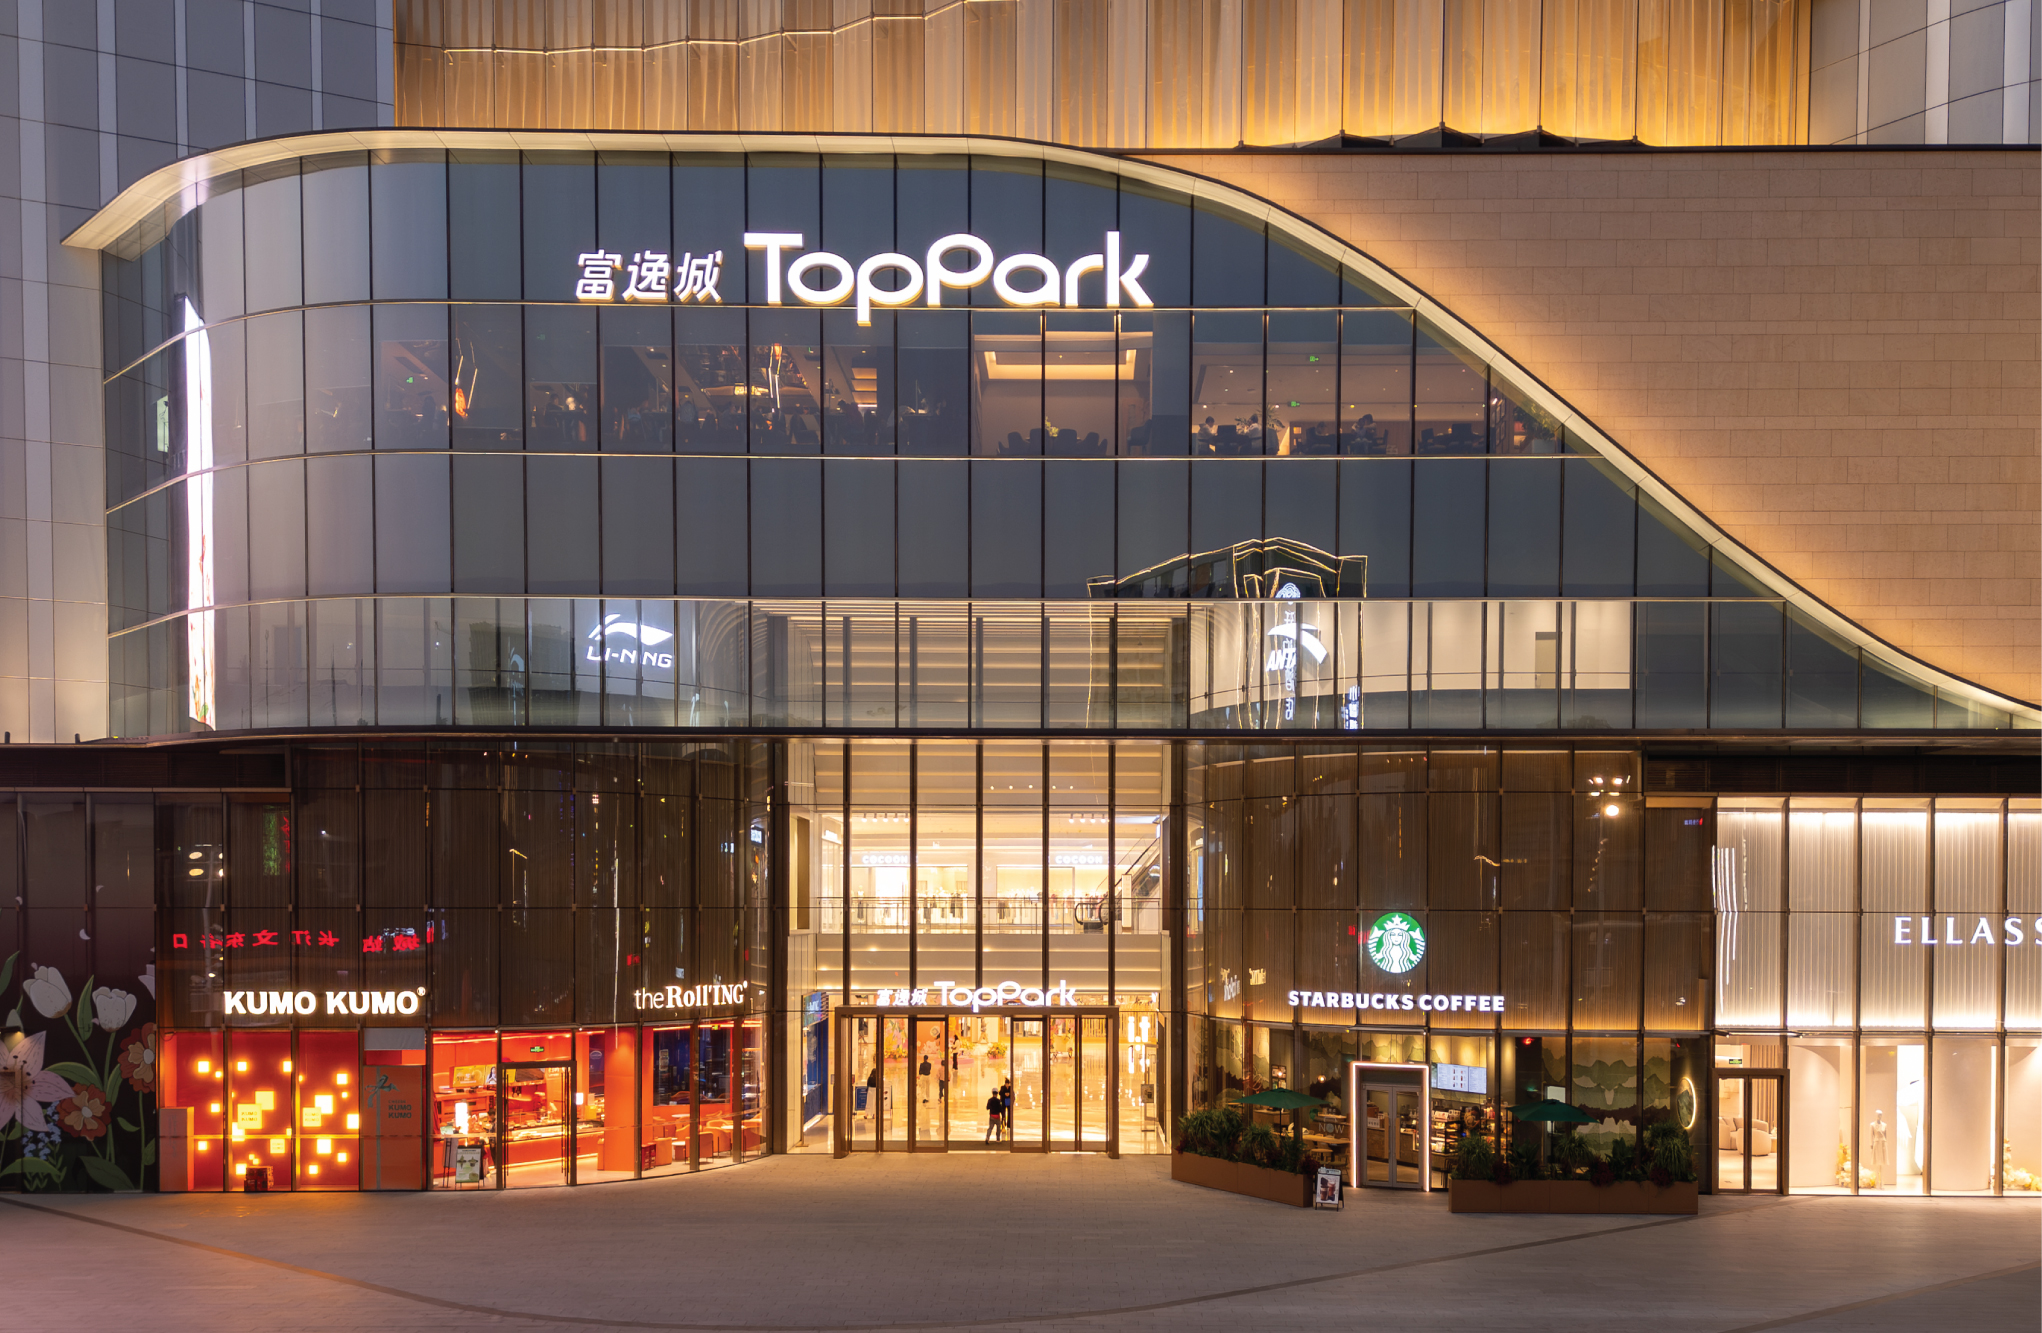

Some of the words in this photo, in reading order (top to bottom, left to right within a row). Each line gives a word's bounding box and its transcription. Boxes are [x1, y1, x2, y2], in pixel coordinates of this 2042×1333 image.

[575, 249, 723, 303] 富逸城
[743, 231, 1154, 324] TopPark
[586, 645, 673, 668] LI-NNG
[862, 854, 908, 864] COCOON
[1055, 854, 1103, 864] COCOON
[223, 990, 317, 1015] KUMO
[875, 988, 928, 1007] 富逸城
[933, 979, 1078, 1013] TopPark
[1288, 990, 1414, 1011] STARBUCKS
[1418, 994, 1505, 1012] COFFEE
